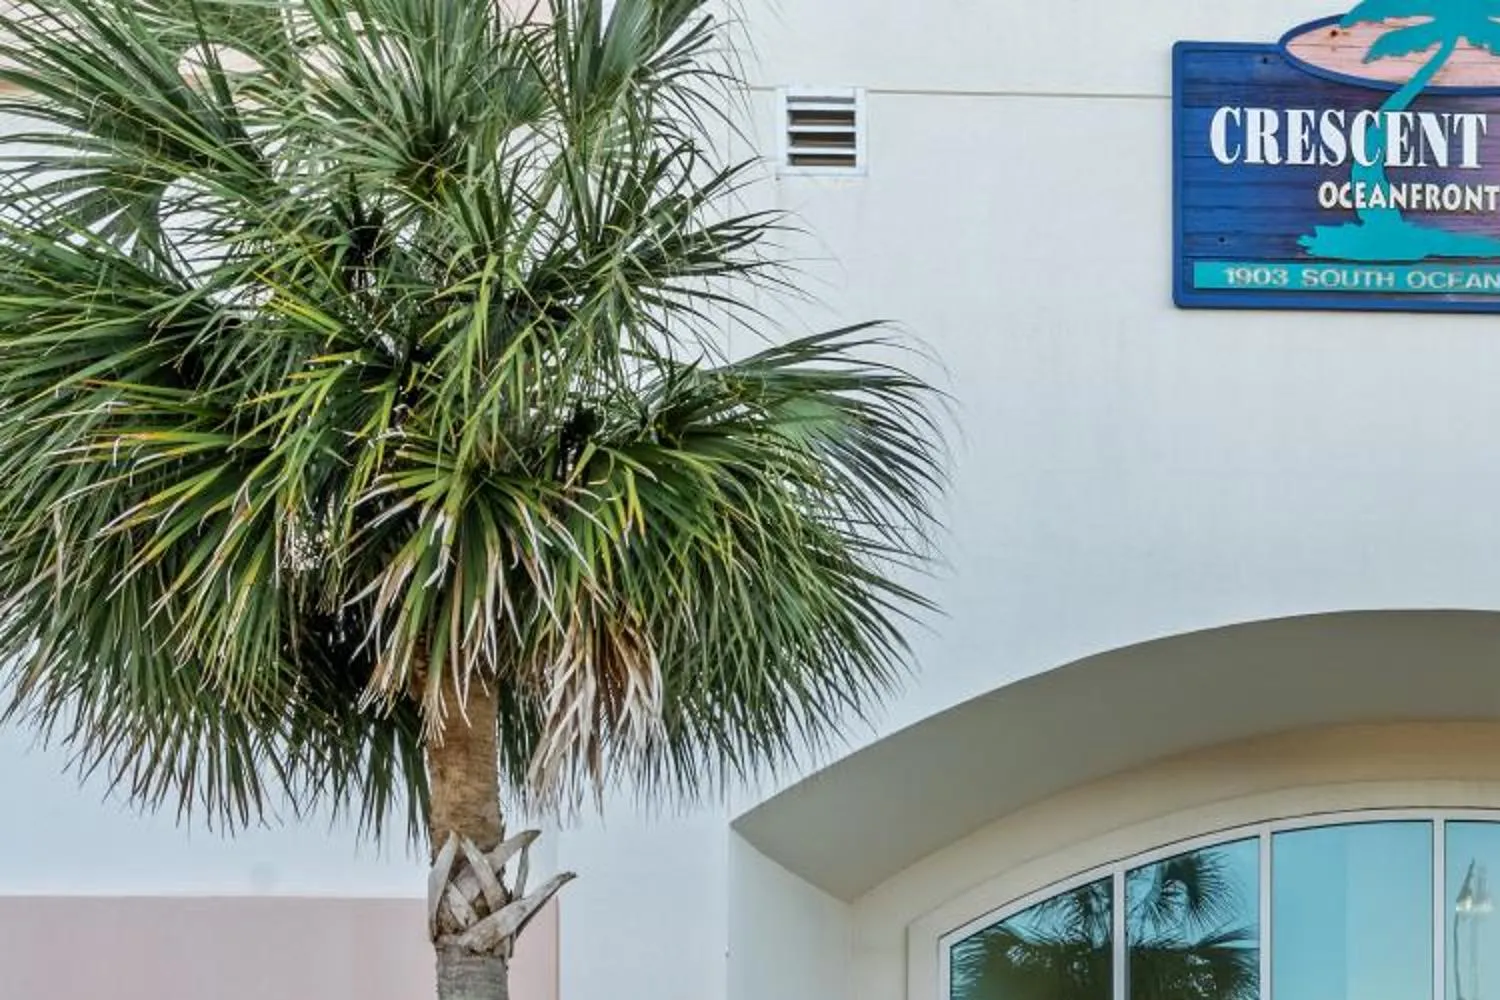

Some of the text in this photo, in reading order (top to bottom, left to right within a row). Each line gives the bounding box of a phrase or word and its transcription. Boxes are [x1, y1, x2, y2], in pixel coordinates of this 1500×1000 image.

[1210, 107, 1487, 168] CRESCENT
[1318, 181, 1500, 210] OCEANFRONT
[1225, 267, 1289, 286] 1903
[1303, 268, 1395, 288] SOUTH
